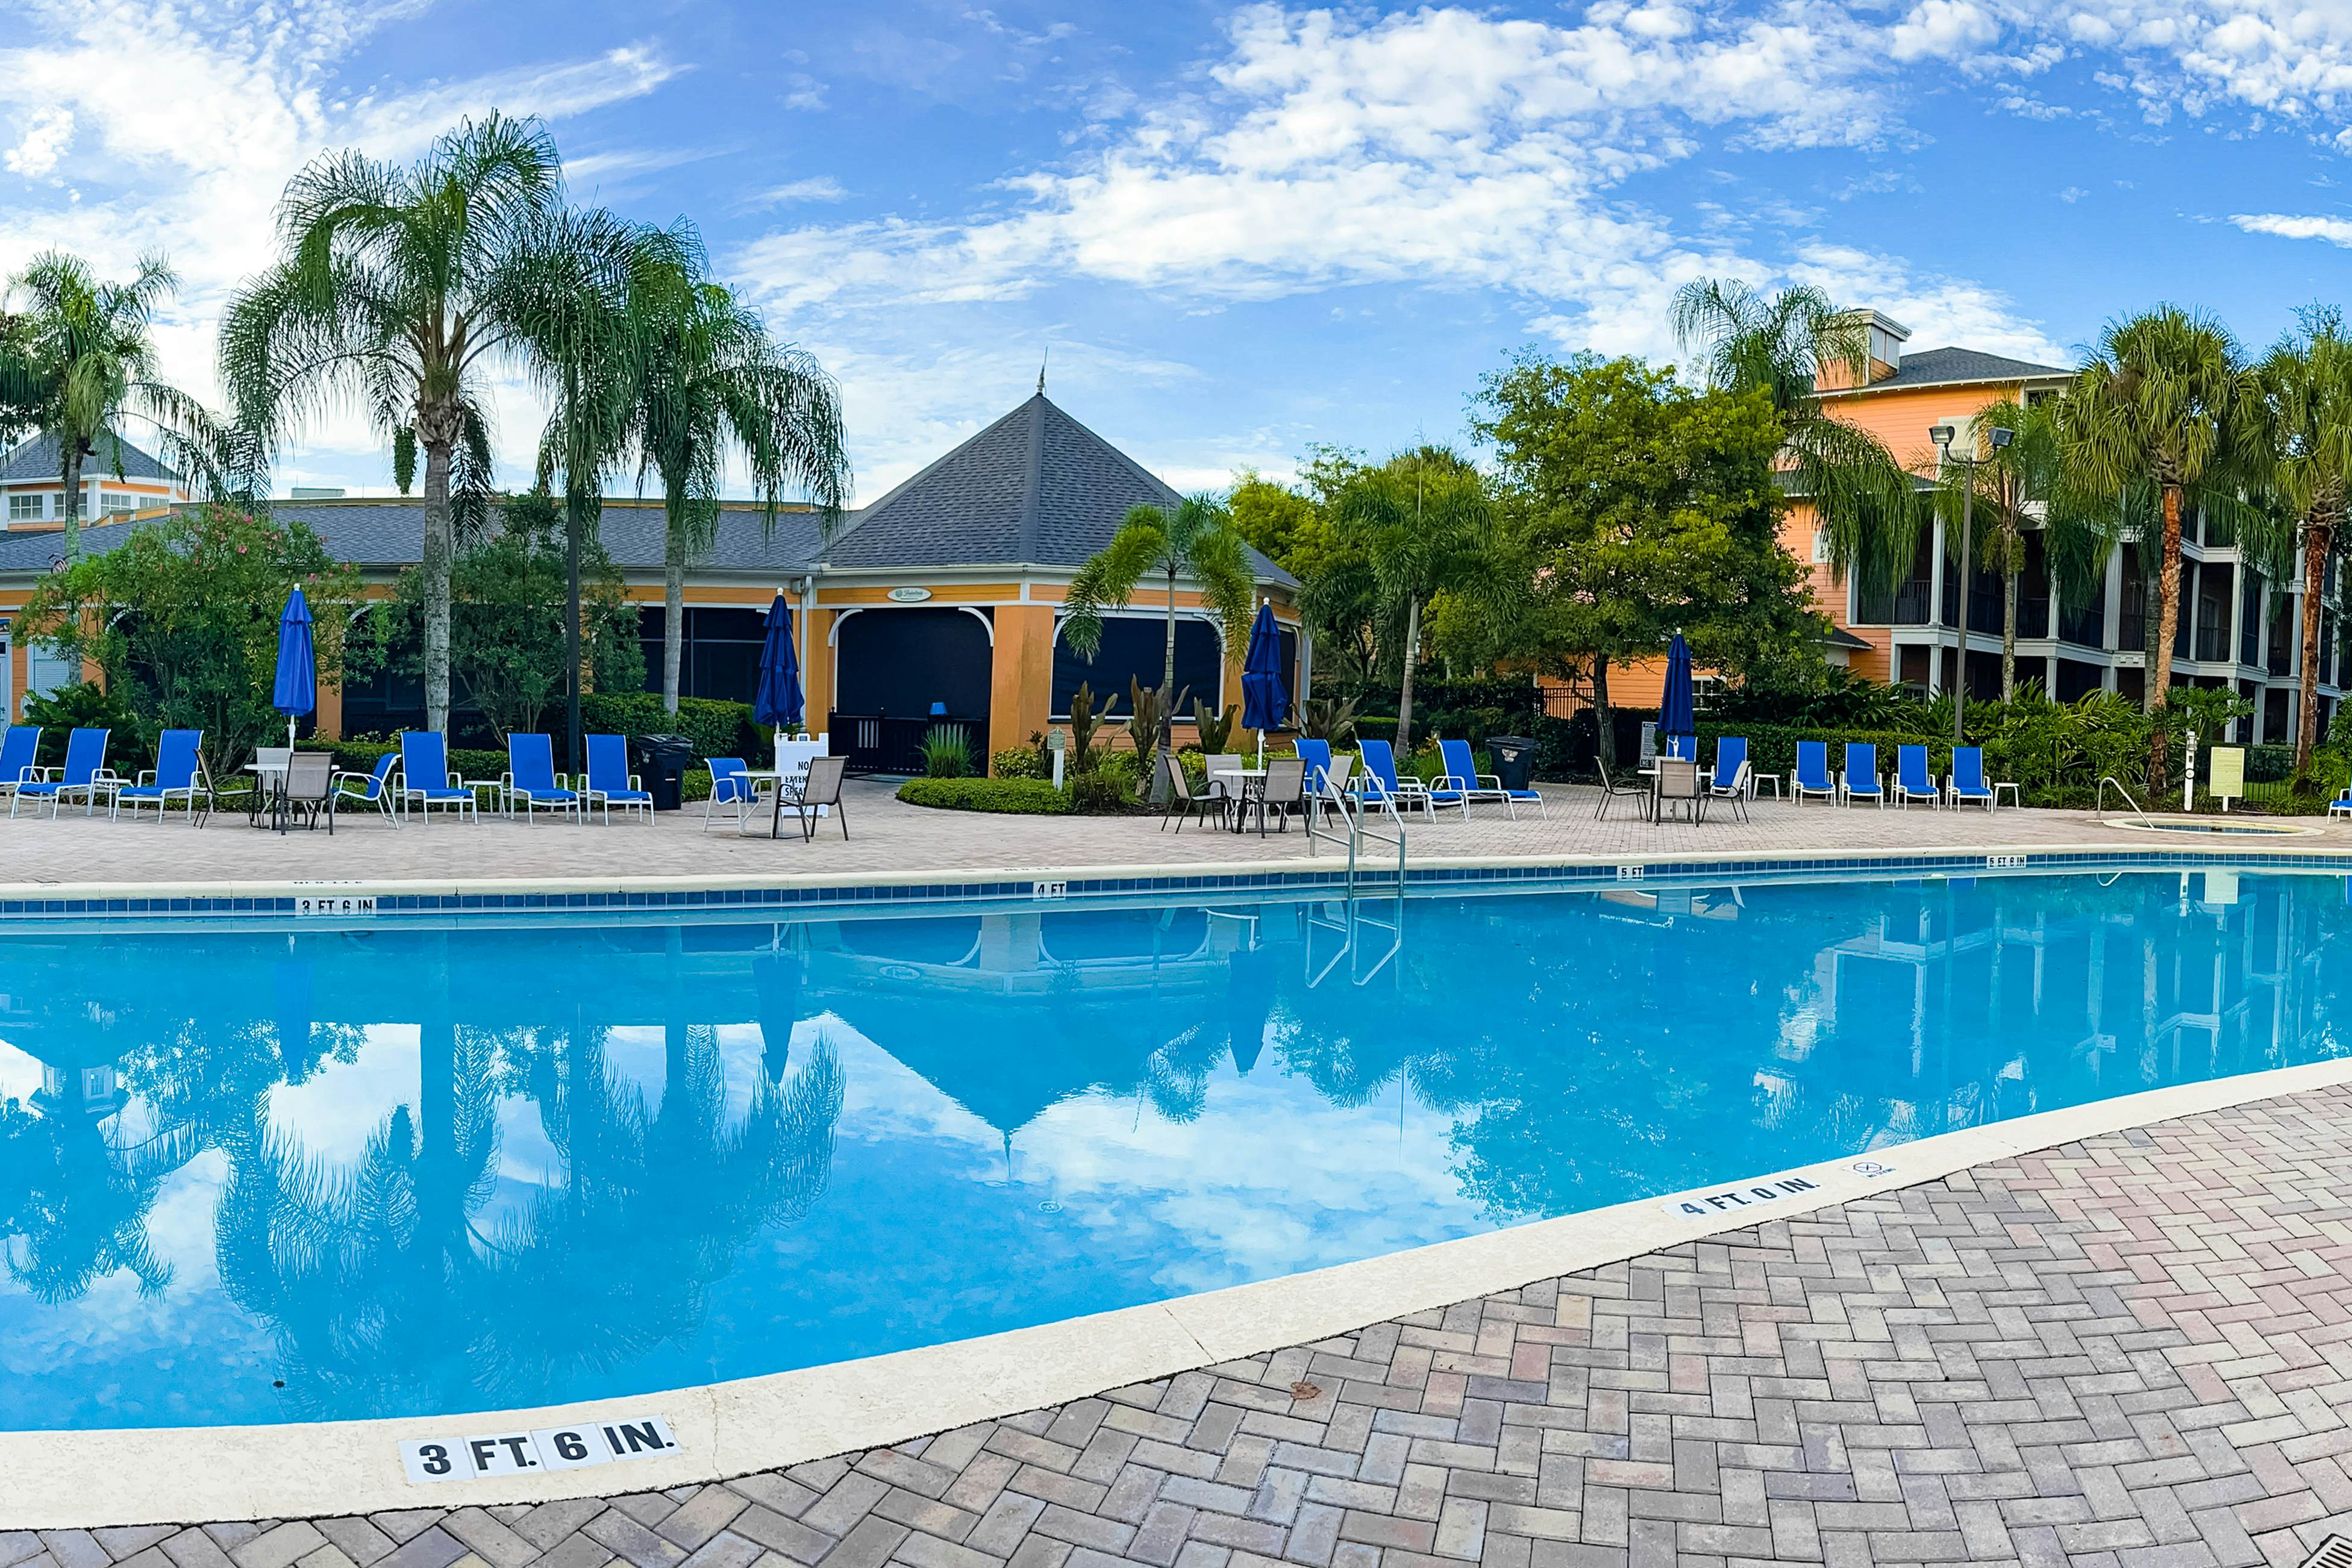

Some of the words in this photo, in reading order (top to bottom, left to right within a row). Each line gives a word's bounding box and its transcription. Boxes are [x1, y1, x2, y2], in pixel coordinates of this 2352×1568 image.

[798, 761, 808, 770] NO
[1051, 883, 1065, 893] FT
[302, 900, 310, 910] 3
[318, 900, 335, 910] FT
[342, 900, 351, 910] 6
[358, 899, 372, 910] IN
[1680, 1202, 1706, 1215] 4
[1705, 1193, 1752, 1210] FT.
[1775, 1178, 1821, 1195] IN.
[419, 1444, 452, 1475] 3
[470, 1436, 537, 1470] FT.
[553, 1432, 588, 1460] 6
[603, 1421, 675, 1455] IN.
